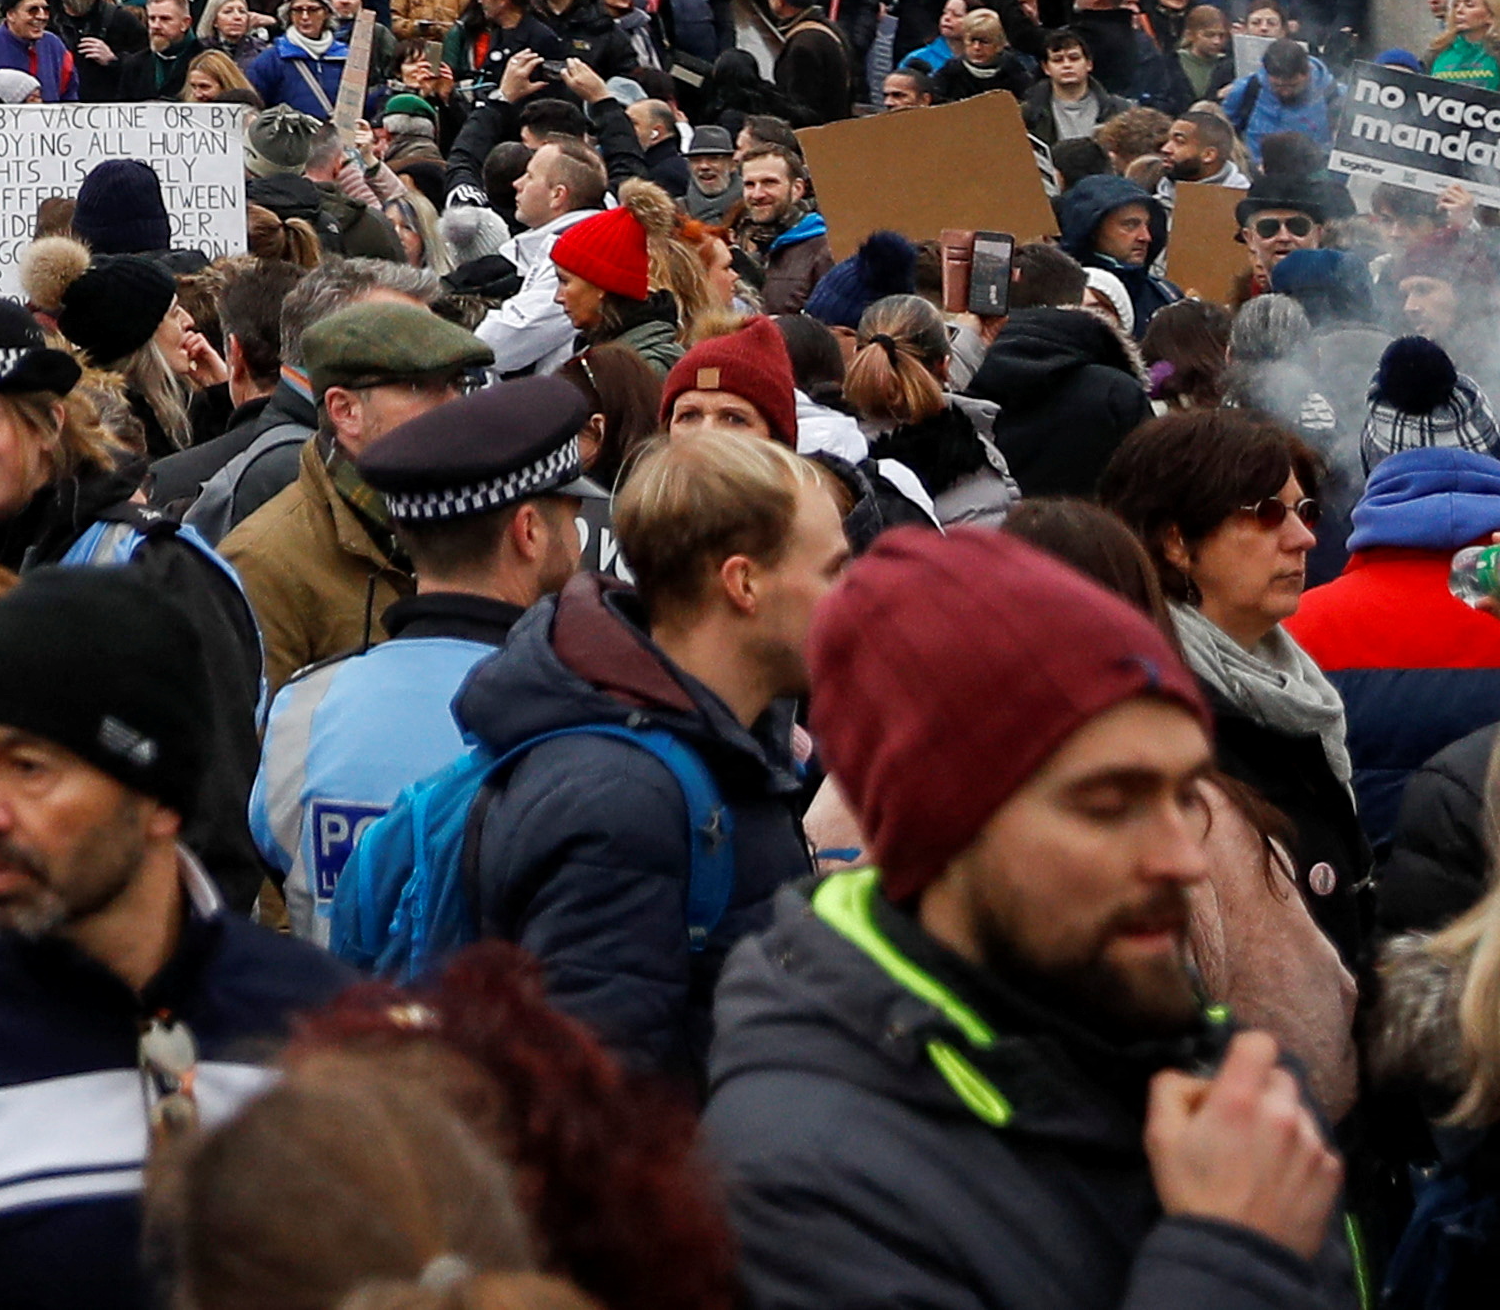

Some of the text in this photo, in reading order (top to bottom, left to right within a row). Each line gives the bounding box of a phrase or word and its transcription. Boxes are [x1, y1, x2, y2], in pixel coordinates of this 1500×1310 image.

[164, 106, 193, 128] OR
[211, 107, 242, 129] BY
[1355, 78, 1500, 133] no vacc
[88, 132, 132, 156] ALL
[149, 132, 228, 156] HUMAN
